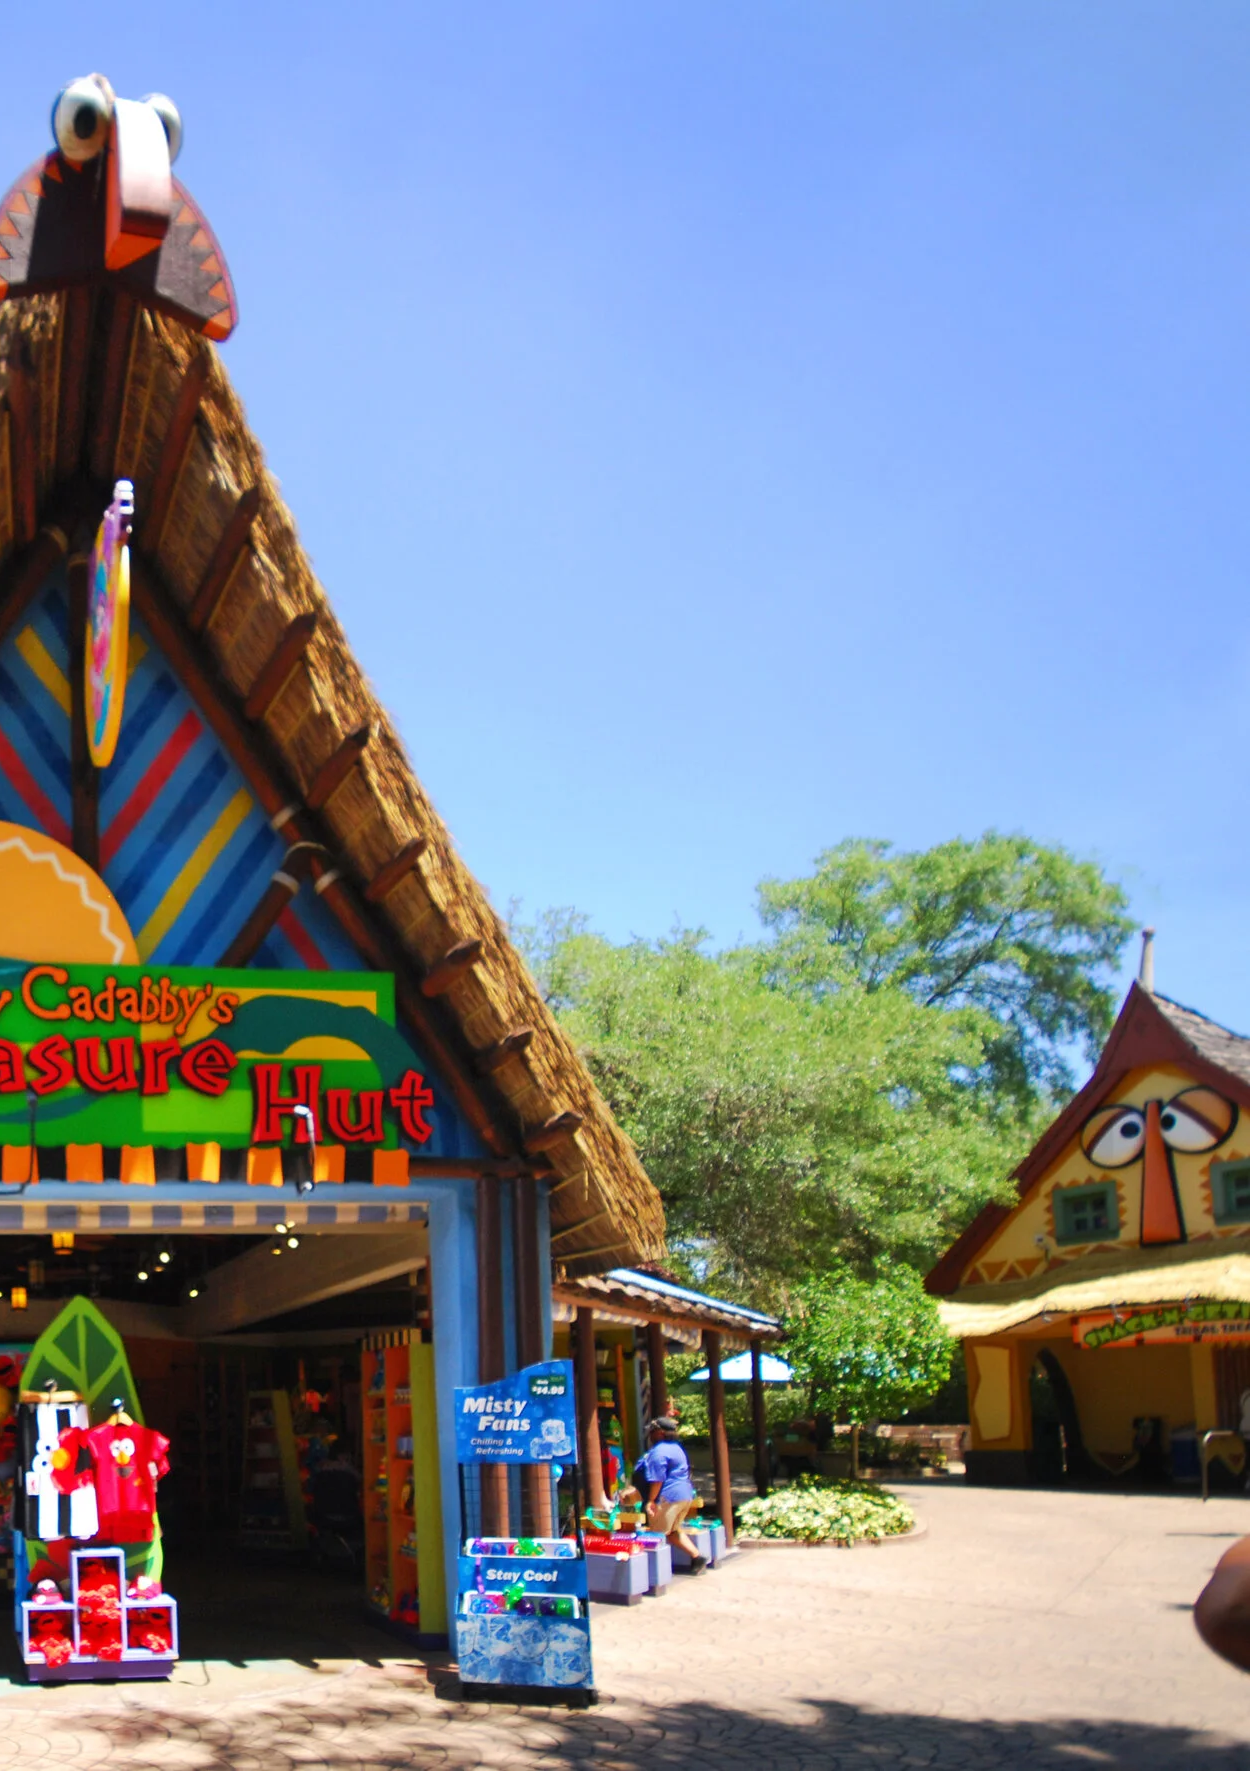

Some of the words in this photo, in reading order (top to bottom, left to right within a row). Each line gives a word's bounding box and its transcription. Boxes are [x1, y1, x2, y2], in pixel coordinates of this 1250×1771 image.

[21, 965, 239, 1036] Cadabby's
[251, 1063, 435, 1145] Hut
[463, 1396, 527, 1417] Misty
[478, 1416, 531, 1431] Fans
[470, 1437, 504, 1447] Chilling
[476, 1447, 523, 1456] Refreshing
[486, 1569, 520, 1583] Stay
[523, 1570, 558, 1581] Cool
